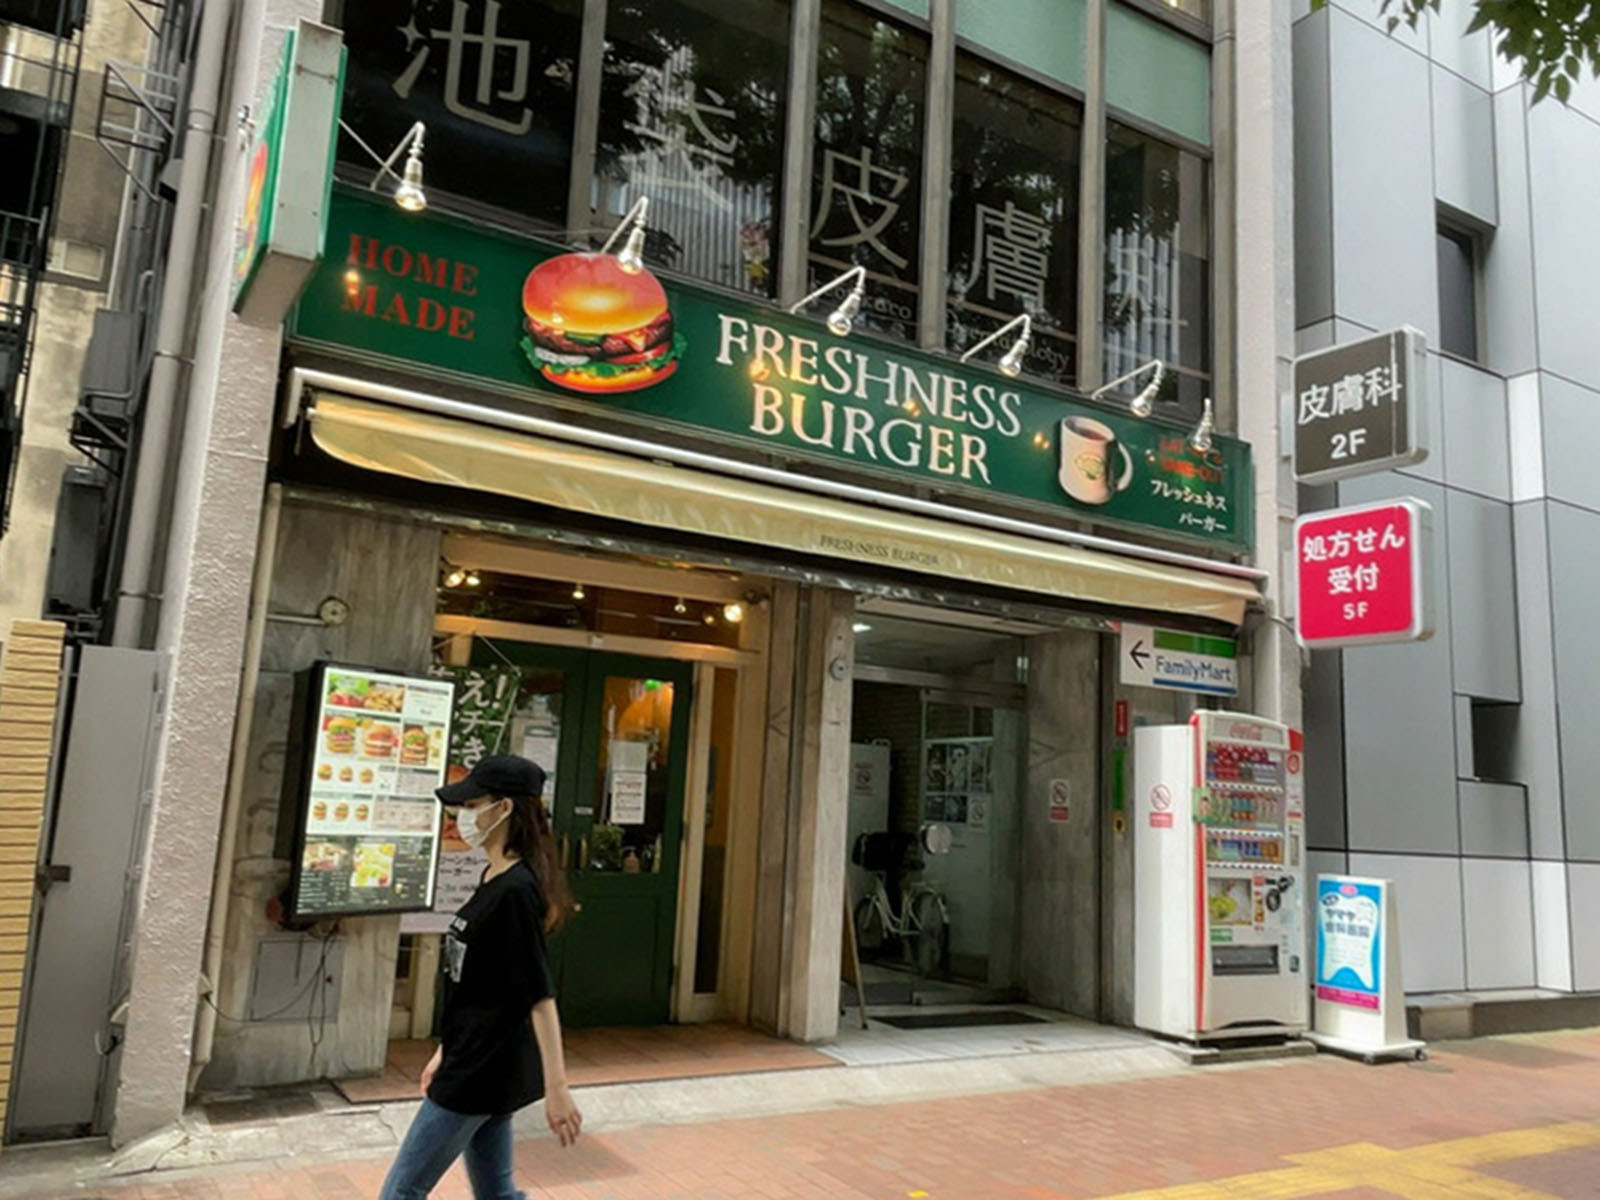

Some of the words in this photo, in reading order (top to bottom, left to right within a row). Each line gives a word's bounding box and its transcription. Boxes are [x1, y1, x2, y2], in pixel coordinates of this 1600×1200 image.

[347, 233, 478, 296] HOME
[340, 281, 476, 341] MADE
[716, 313, 1022, 438] FRESHNESS
[1298, 362, 1403, 425] 皮膚科
[749, 383, 991, 484] BURGER
[1331, 428, 1367, 460] 2F
[1151, 480, 1228, 513] フレッシュネス
[1178, 511, 1228, 533] バーガー
[1302, 524, 1406, 563] 処方せん
[1327, 562, 1380, 594] 受付
[1342, 601, 1369, 621] 5F
[1154, 655, 1232, 683] FamilyMart
